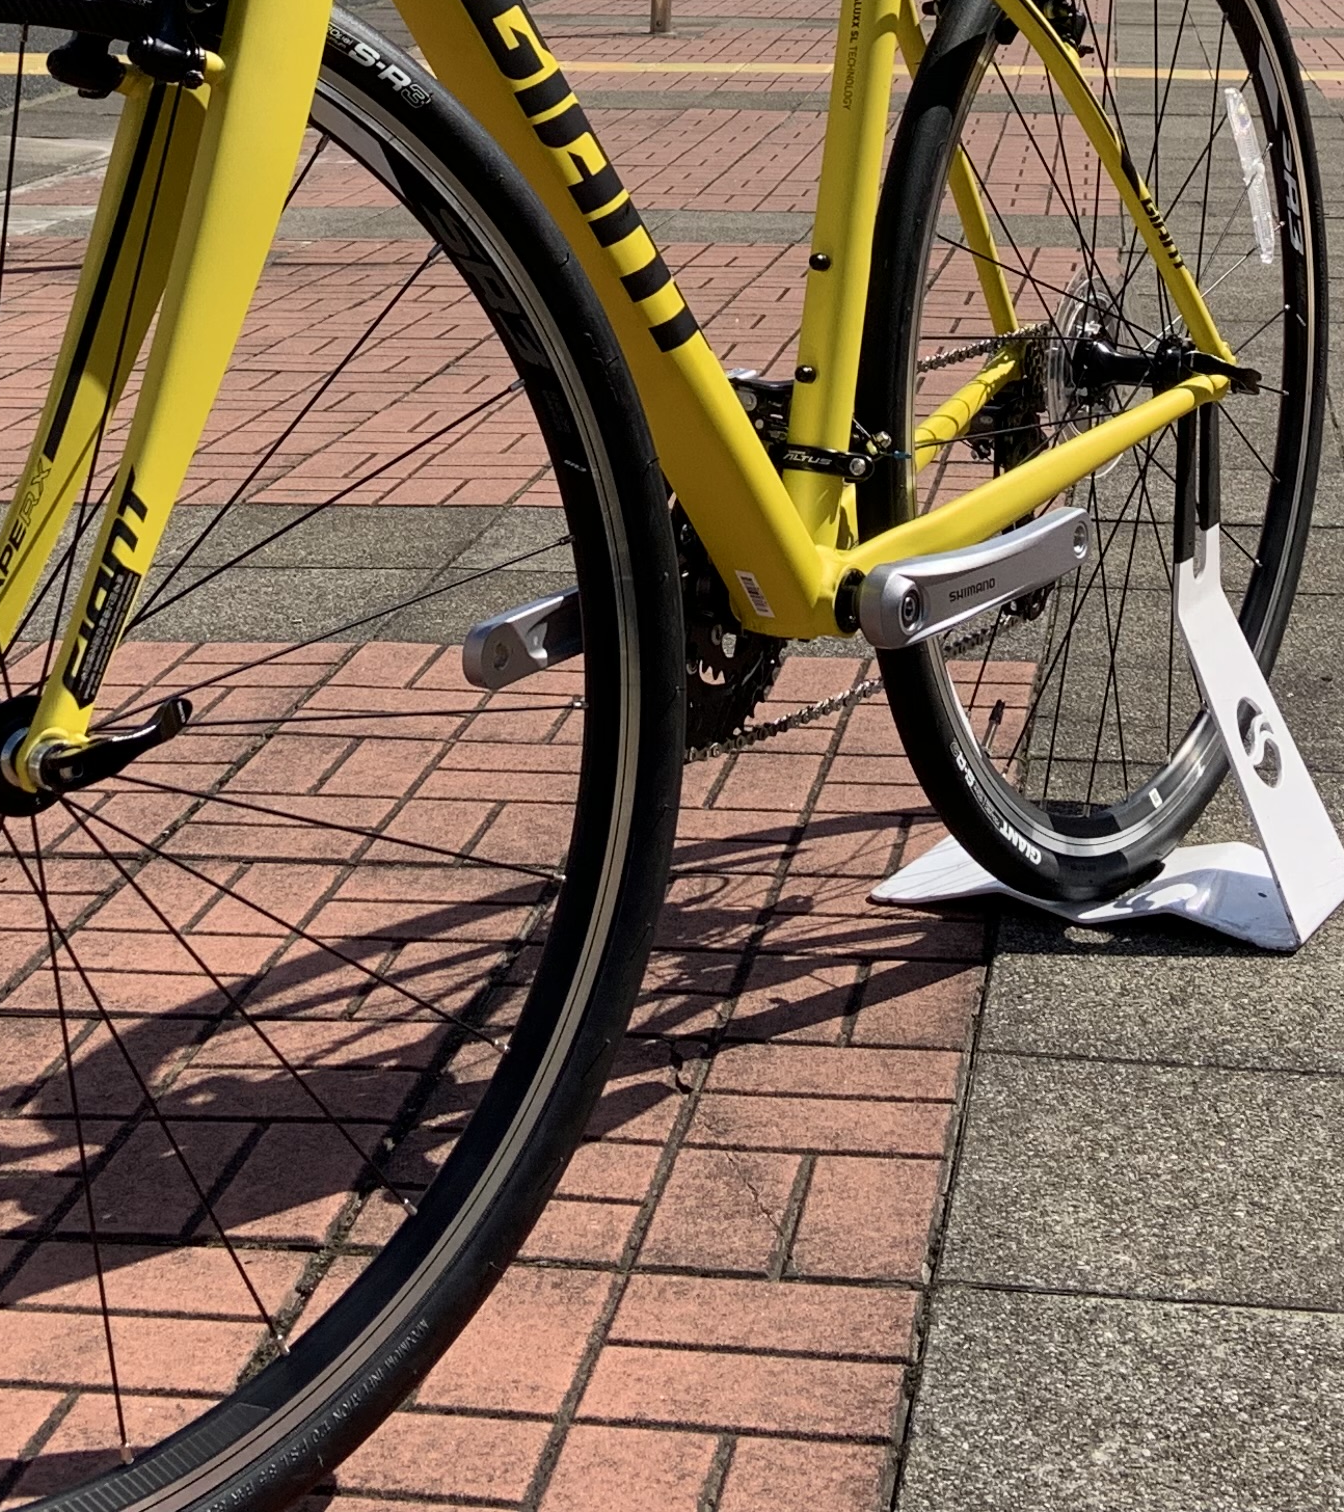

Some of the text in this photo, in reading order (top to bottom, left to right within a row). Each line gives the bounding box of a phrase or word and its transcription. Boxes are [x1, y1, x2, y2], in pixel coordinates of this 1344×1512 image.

[849, 30, 860, 44] SL
[842, 46, 859, 112] TECHNOLOGY
[1140, 197, 1186, 270] GIANT
[783, 454, 833, 466] ALTUS
[949, 577, 996, 602] SHIMANO
[999, 819, 1043, 865] GIANT
